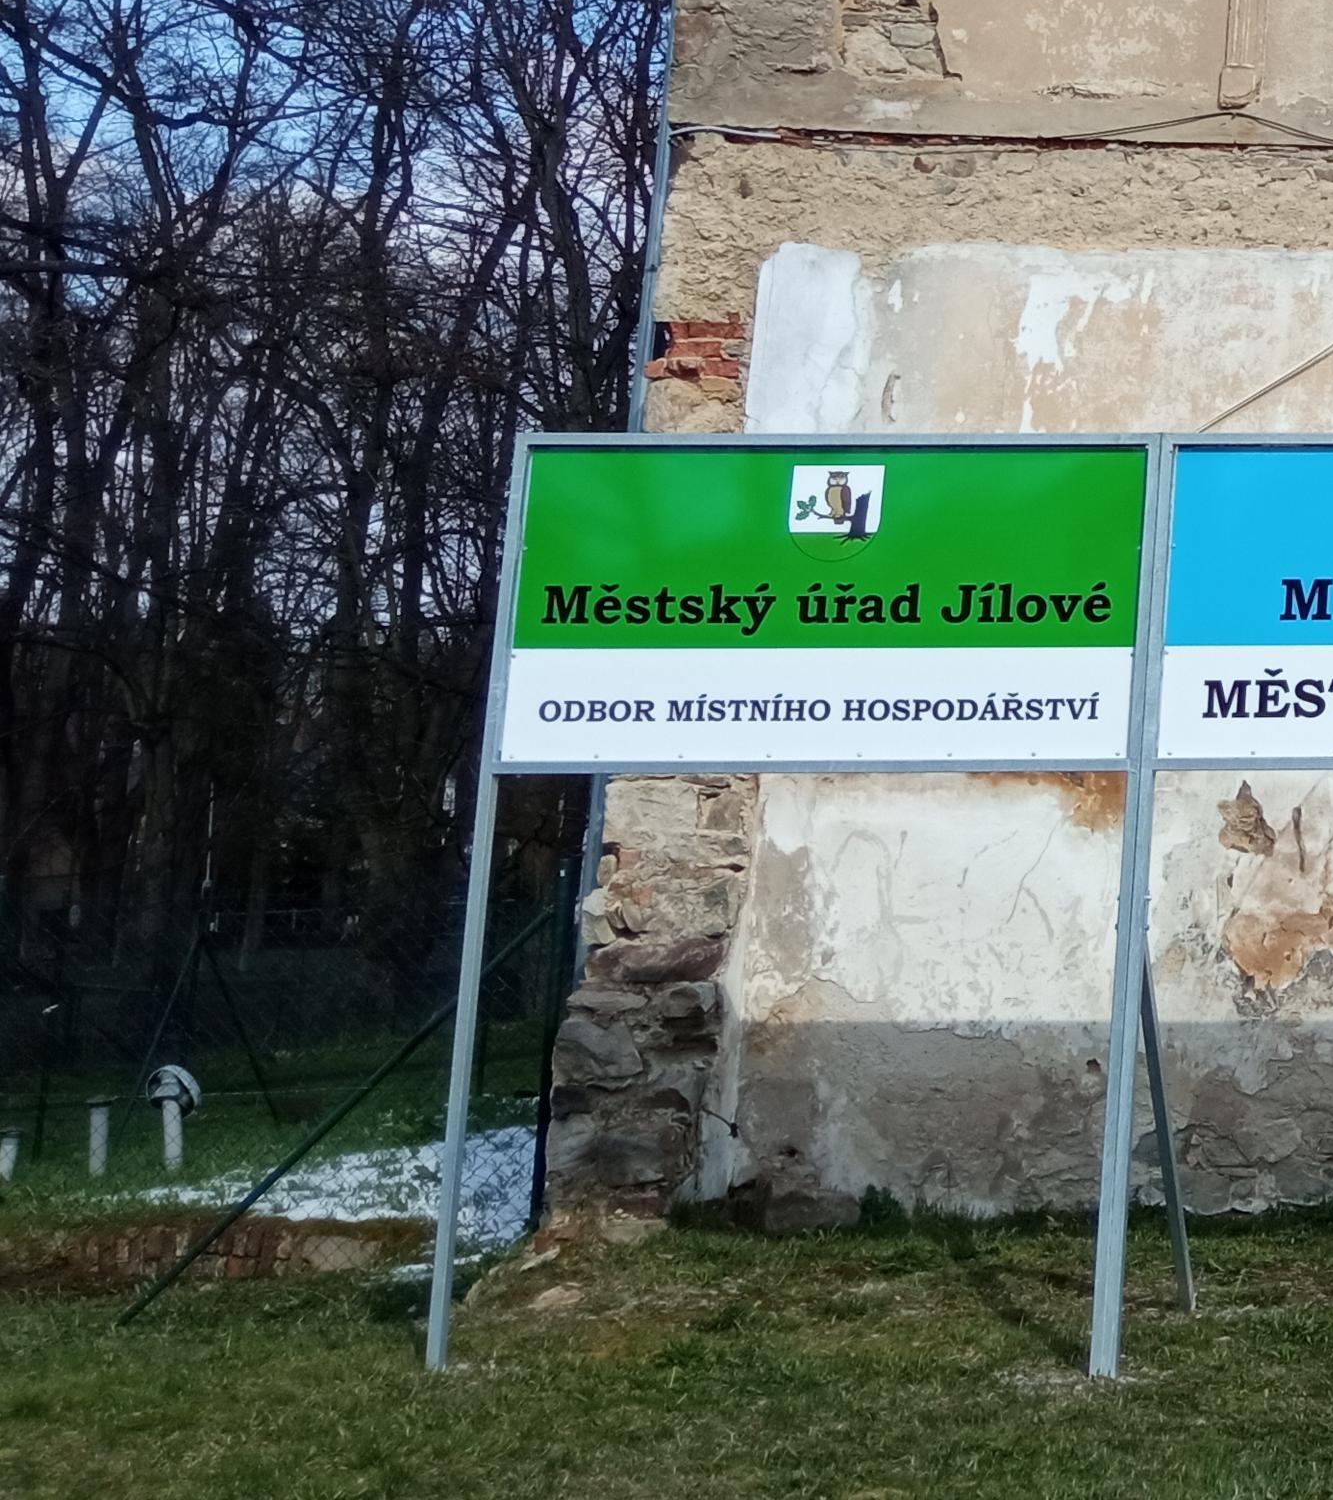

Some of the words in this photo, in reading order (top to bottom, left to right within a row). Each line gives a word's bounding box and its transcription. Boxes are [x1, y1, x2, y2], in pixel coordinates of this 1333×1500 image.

[540, 583, 777, 636] Městský
[797, 582, 922, 625] úřad
[941, 581, 1113, 624] Jílové
[538, 698, 656, 723] ODBOR
[666, 692, 831, 722] MÍSTNÍHO
[842, 691, 1100, 722] HOSPODÁŘSTVÍ
